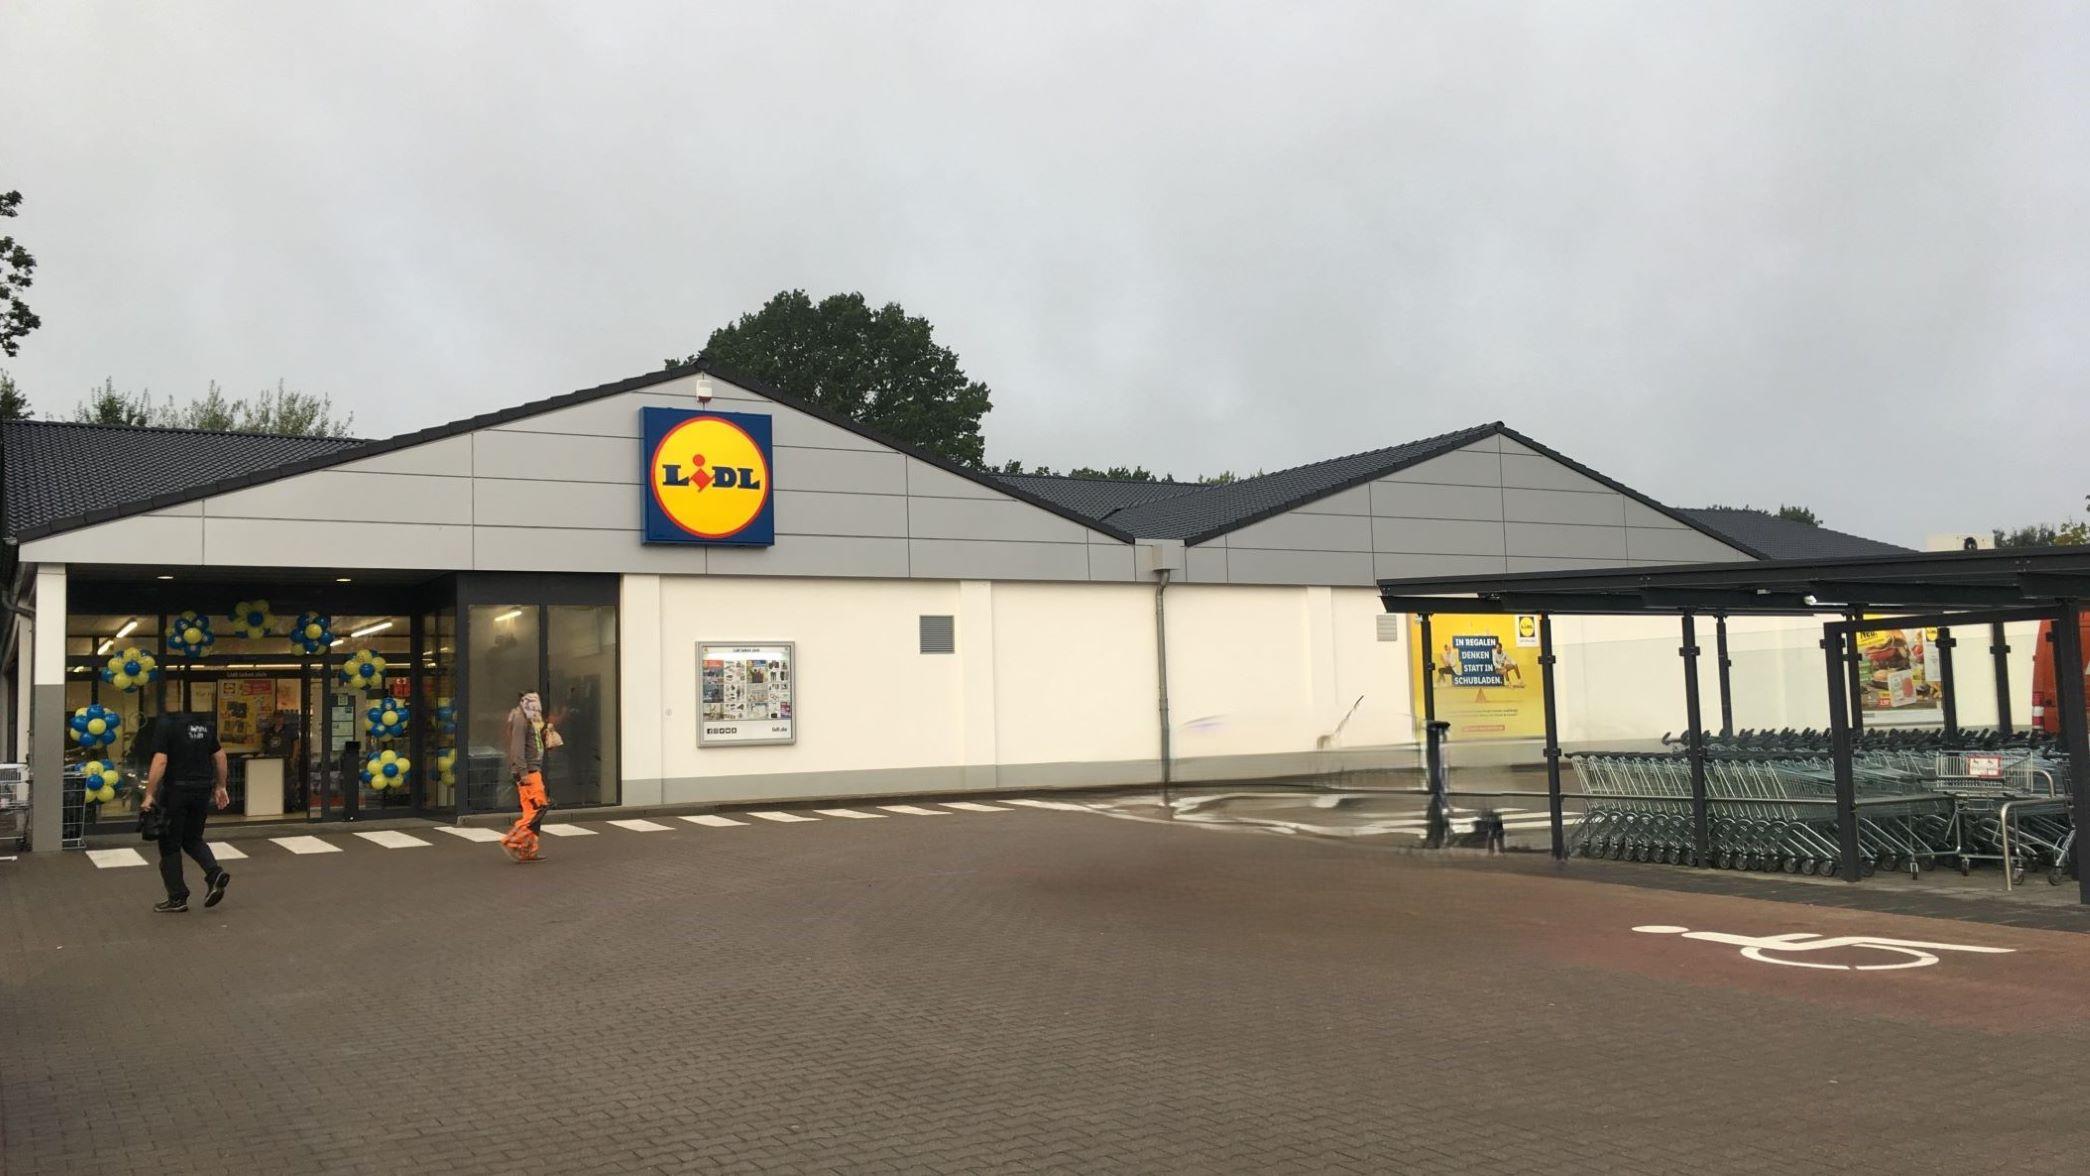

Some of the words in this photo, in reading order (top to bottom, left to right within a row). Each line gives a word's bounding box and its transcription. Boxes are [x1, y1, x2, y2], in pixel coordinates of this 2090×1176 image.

[1455, 638, 1465, 646] IN
[1465, 638, 1496, 646] REGALEN
[1462, 651, 1490, 659] DENKEN
[1463, 664, 1484, 672] STATT
[1484, 664, 1493, 672] IN
[1454, 676, 1503, 685] SCHUBLADEN.
